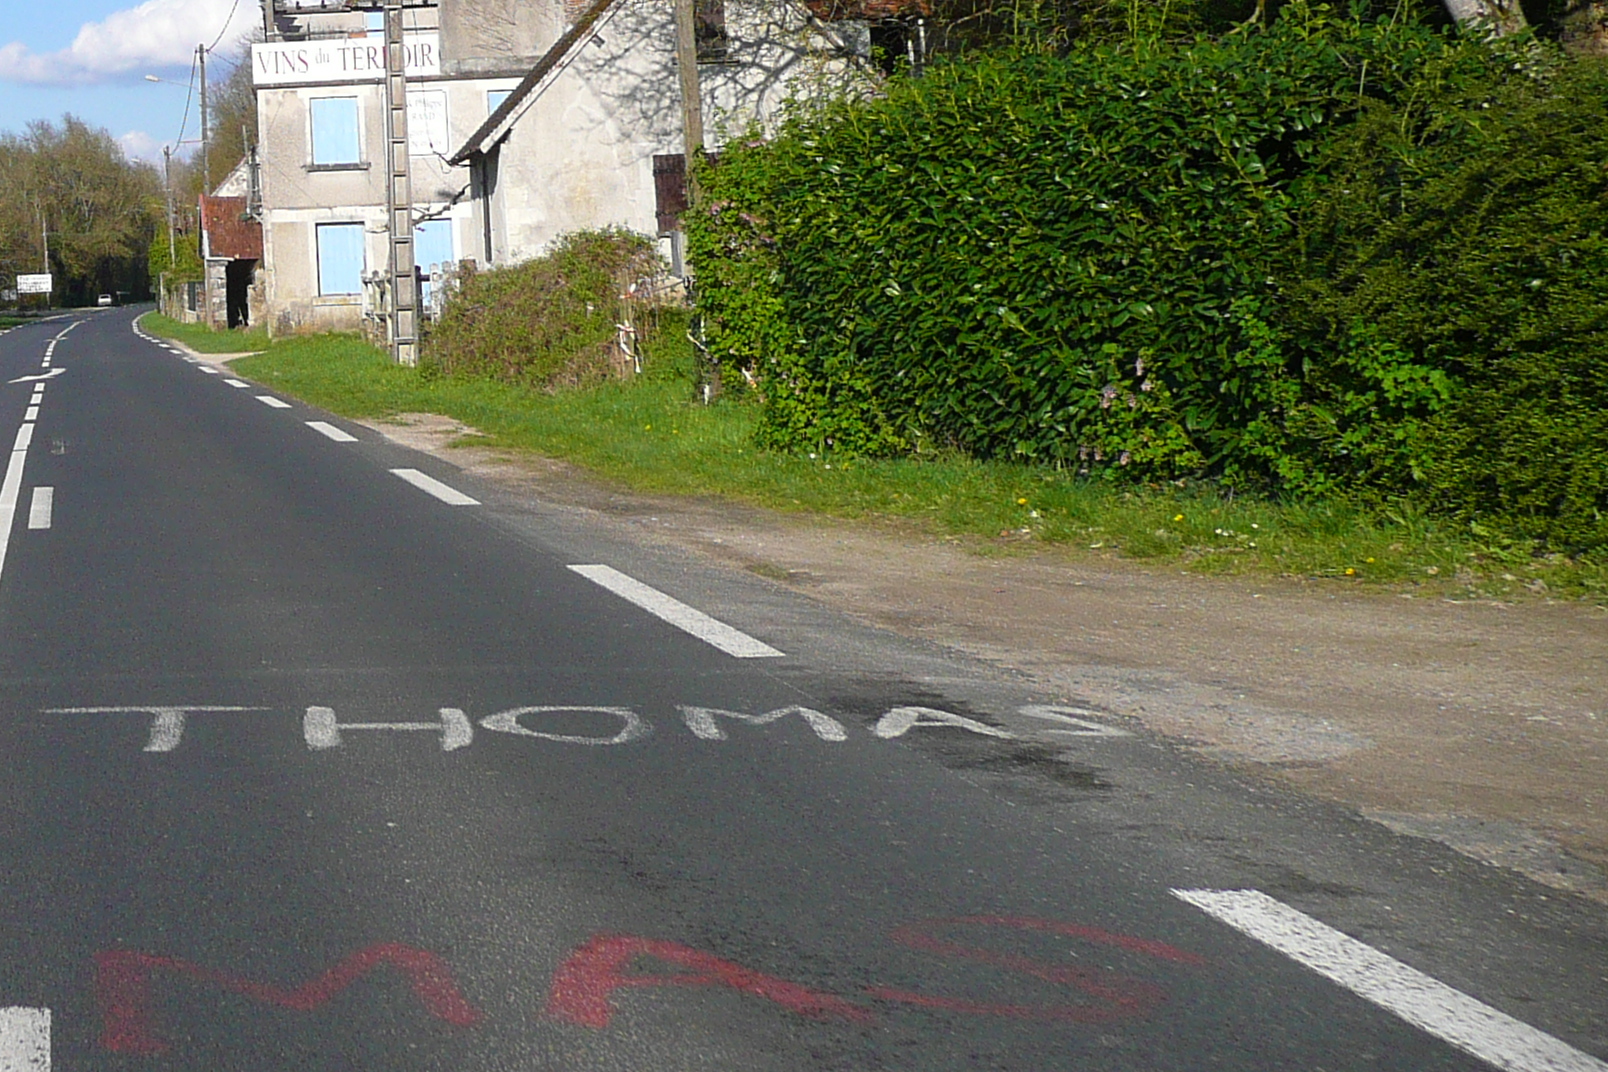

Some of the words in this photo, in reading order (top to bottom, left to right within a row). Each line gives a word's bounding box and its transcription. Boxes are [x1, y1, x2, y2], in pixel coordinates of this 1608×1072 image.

[257, 49, 309, 75] VINS
[315, 48, 330, 64] du
[337, 43, 435, 71] TEROIR
[39, 704, 1140, 754] THOMAS
